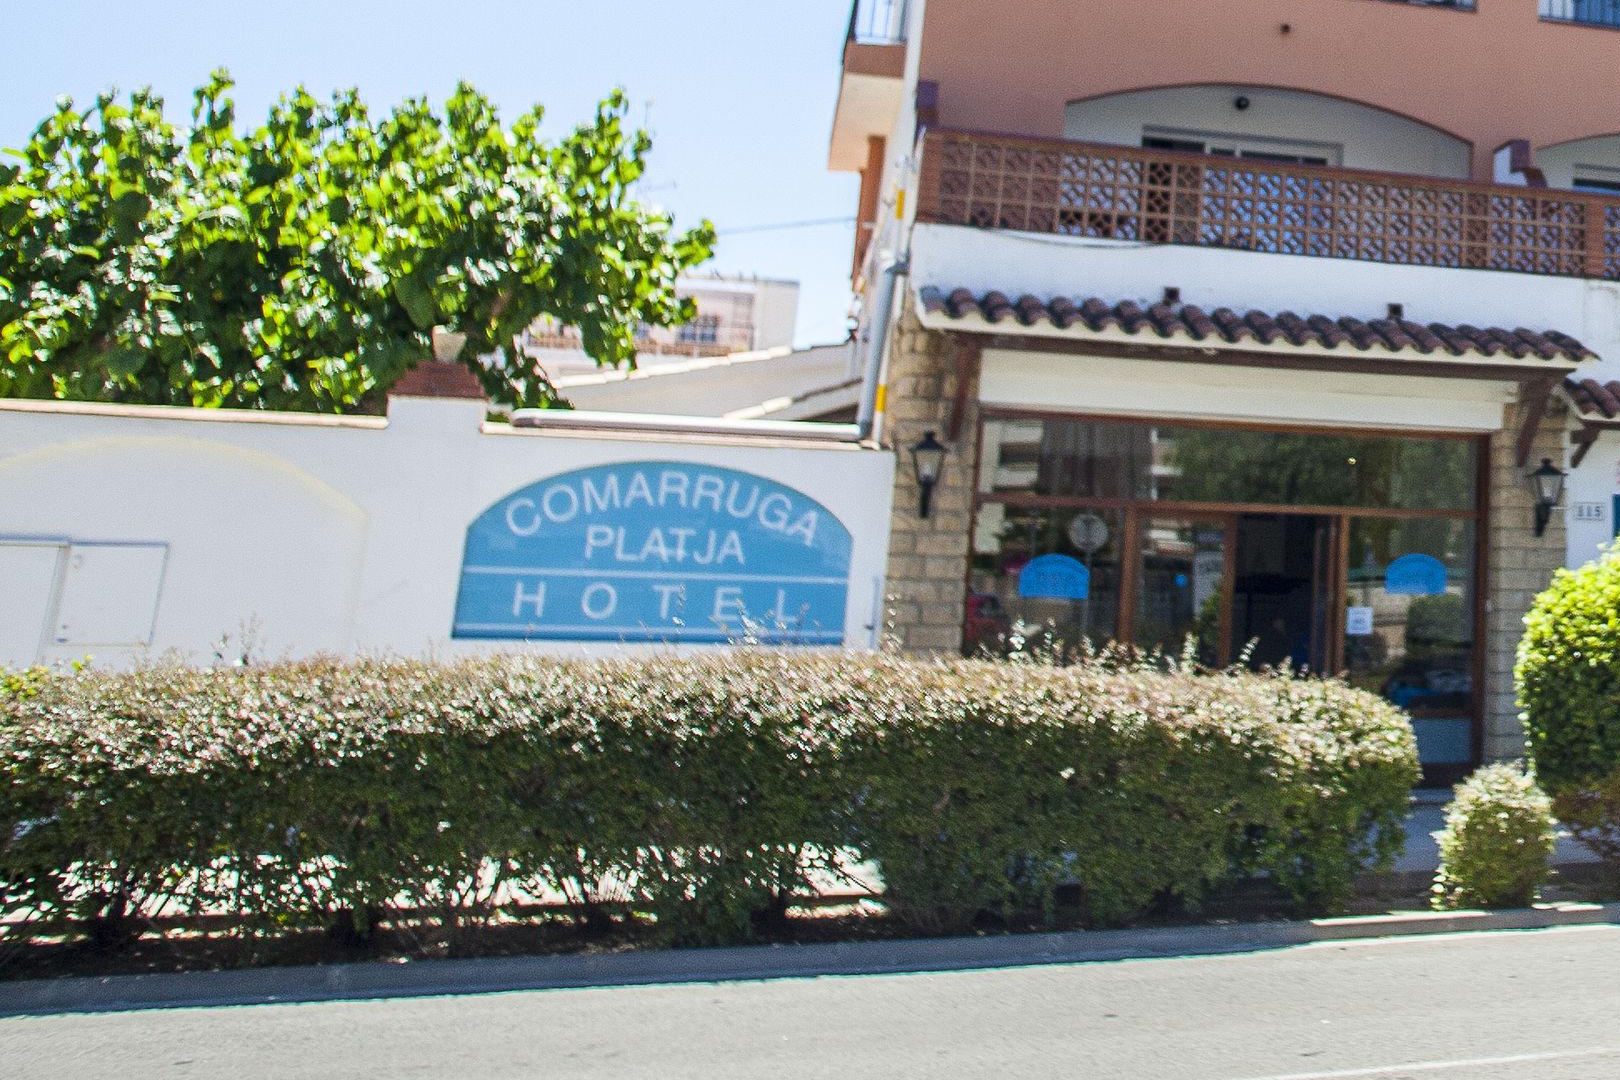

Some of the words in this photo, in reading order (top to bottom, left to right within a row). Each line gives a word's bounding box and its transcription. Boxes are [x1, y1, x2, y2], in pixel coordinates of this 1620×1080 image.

[506, 471, 819, 546] COMARRUGA
[585, 524, 746, 565] PLATJA
[512, 581, 798, 623] HOTEL
